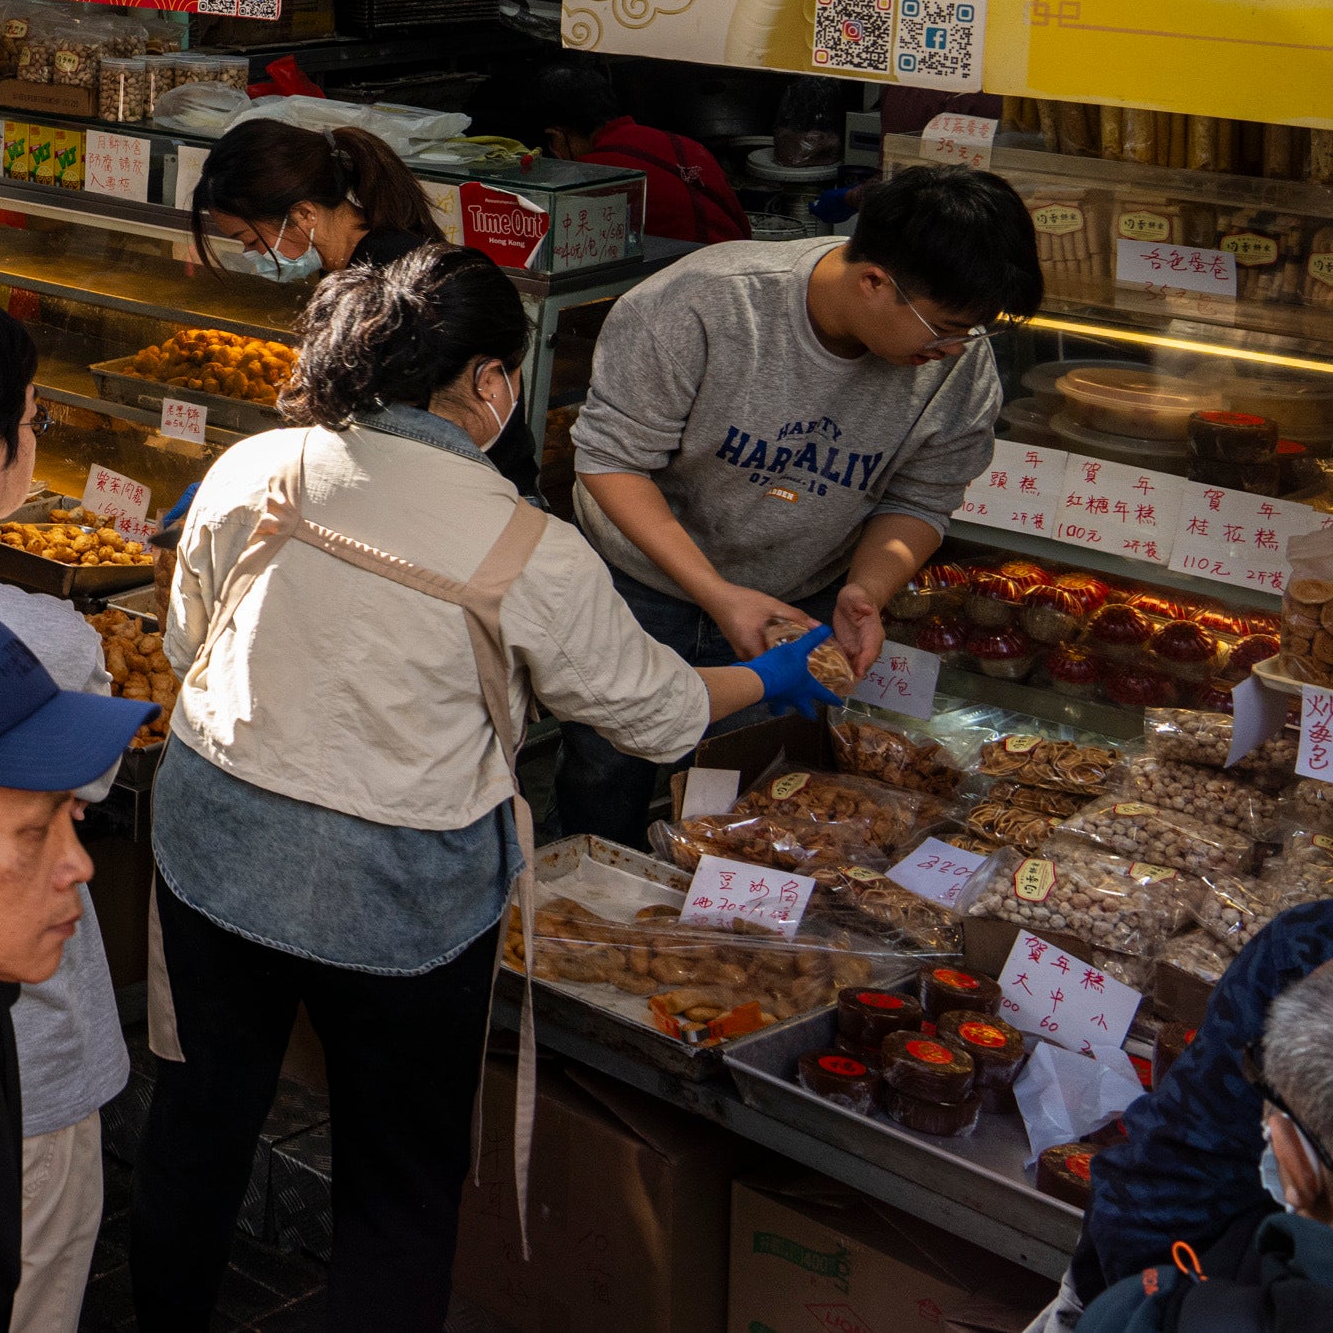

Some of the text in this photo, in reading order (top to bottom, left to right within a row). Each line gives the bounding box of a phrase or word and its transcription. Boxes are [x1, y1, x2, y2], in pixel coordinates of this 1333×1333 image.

[488, 237, 526, 249] Hong Kong
[1025, 937, 1106, 995] 賀年糕
[1039, 1015, 1059, 1032] 60
